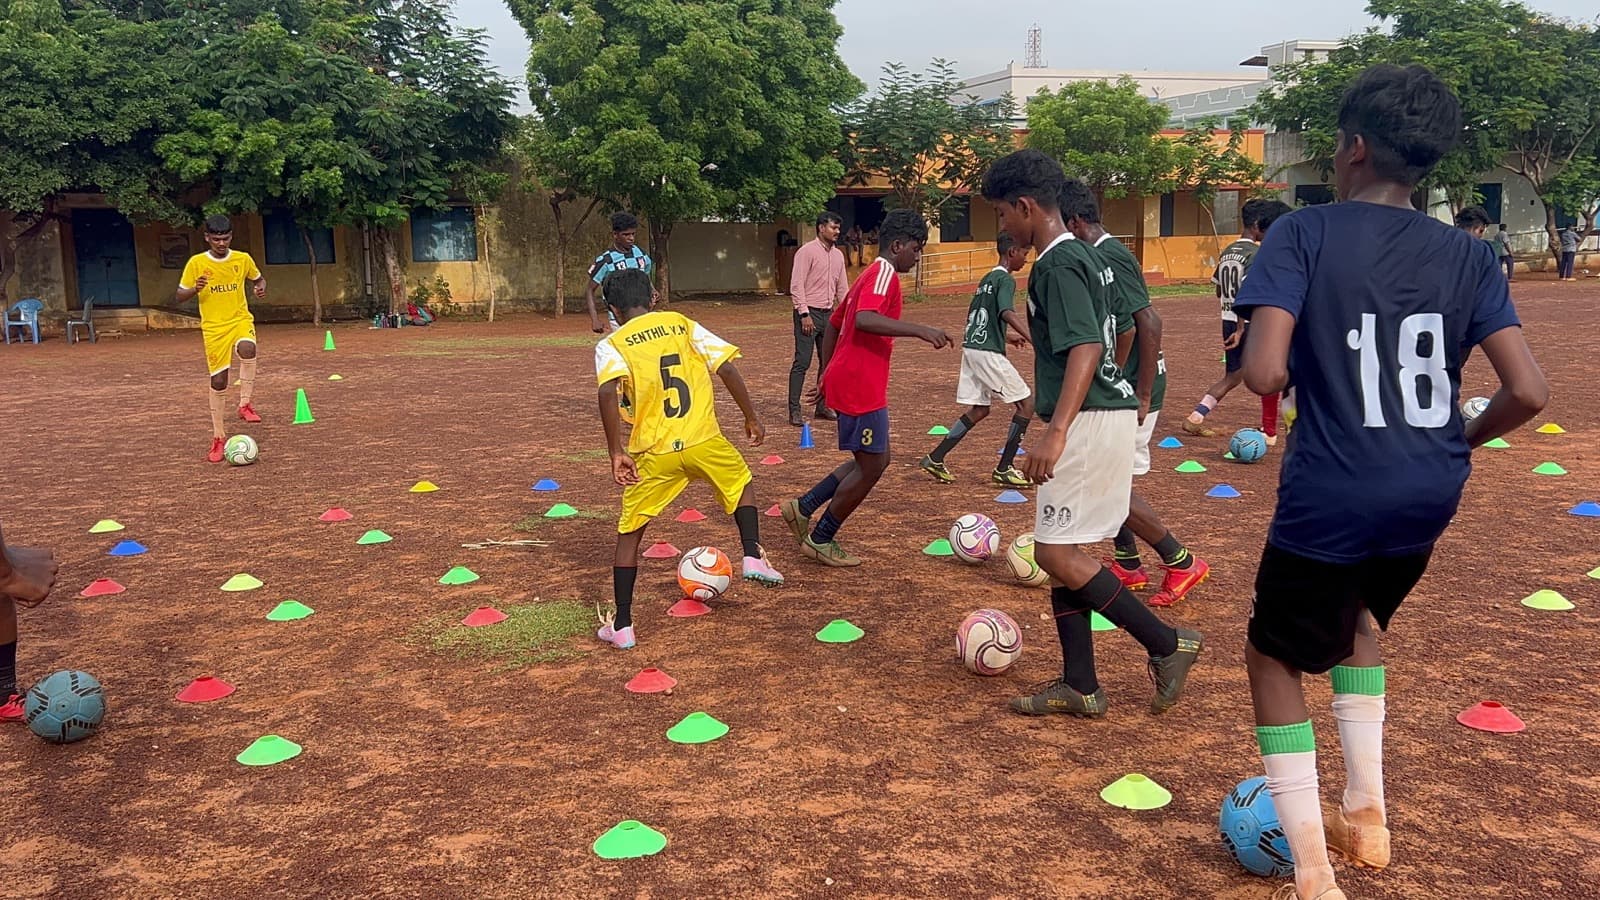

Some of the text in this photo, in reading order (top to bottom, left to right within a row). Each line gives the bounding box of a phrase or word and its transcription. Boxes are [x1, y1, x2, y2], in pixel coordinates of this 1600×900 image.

[210, 283, 238, 294] MELUR
[625, 325, 669, 346] SENTHIL
[1347, 312, 1451, 428] 18
[660, 353, 691, 418] 5
[861, 428, 873, 446] 3
[1041, 504, 1072, 528] 20
